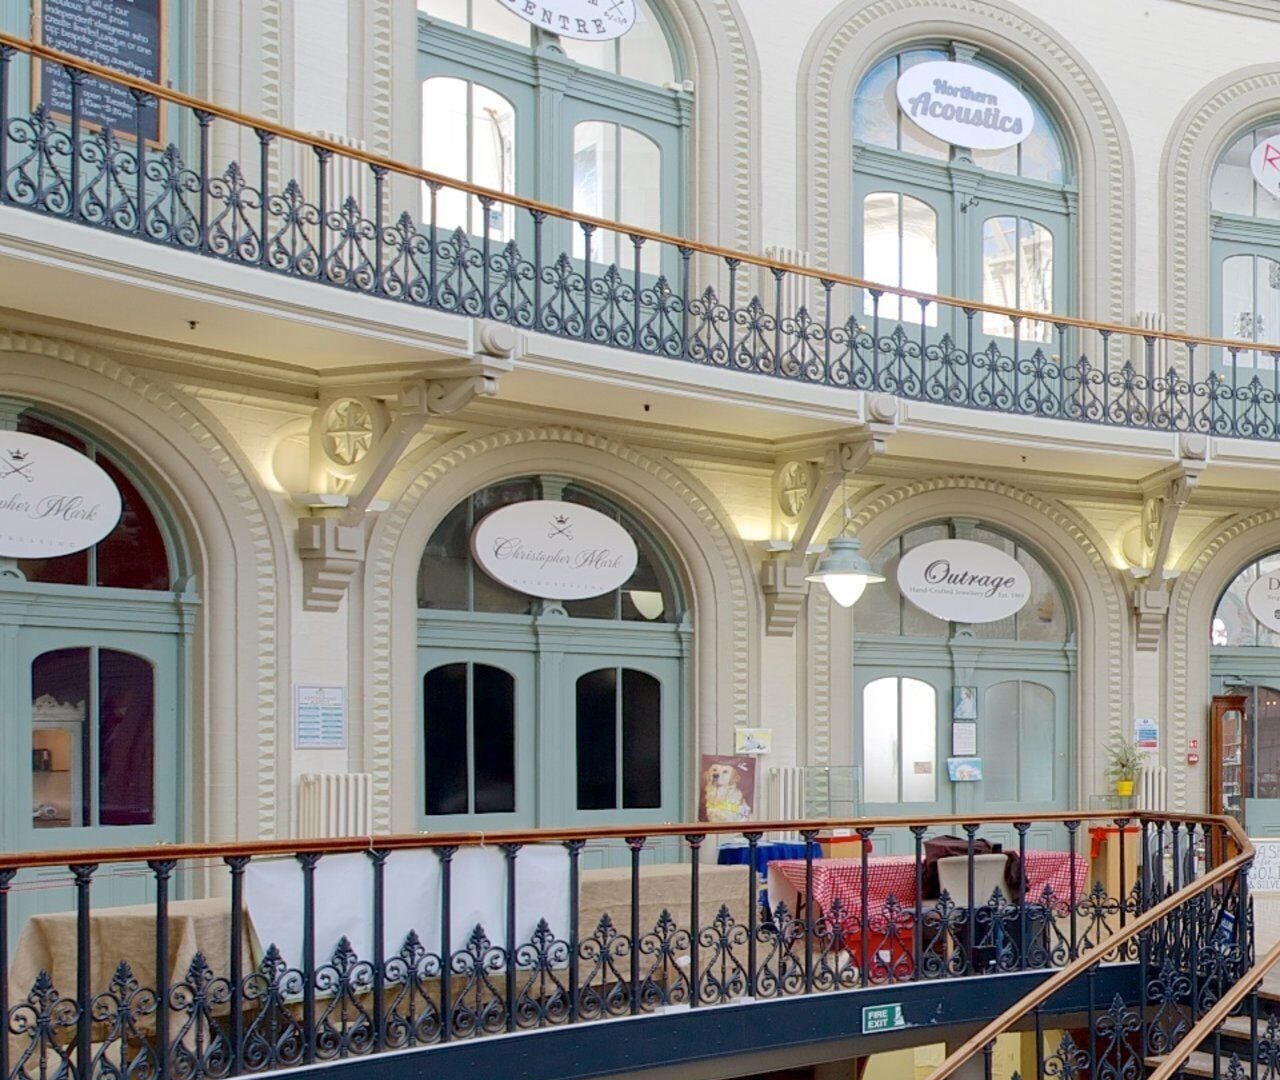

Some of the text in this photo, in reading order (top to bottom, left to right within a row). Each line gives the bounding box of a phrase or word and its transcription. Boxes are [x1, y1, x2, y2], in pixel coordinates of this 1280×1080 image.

[511, 0, 606, 34] ENTRE
[933, 78, 998, 105] Northern
[908, 92, 1023, 135] Acoustics
[36, 495, 100, 521] Mark
[494, 537, 624, 569] Christopher Mark
[924, 559, 1015, 598] Outrage
[867, 1019, 889, 1029] EXIT
[868, 1010, 889, 1020] FIRE
